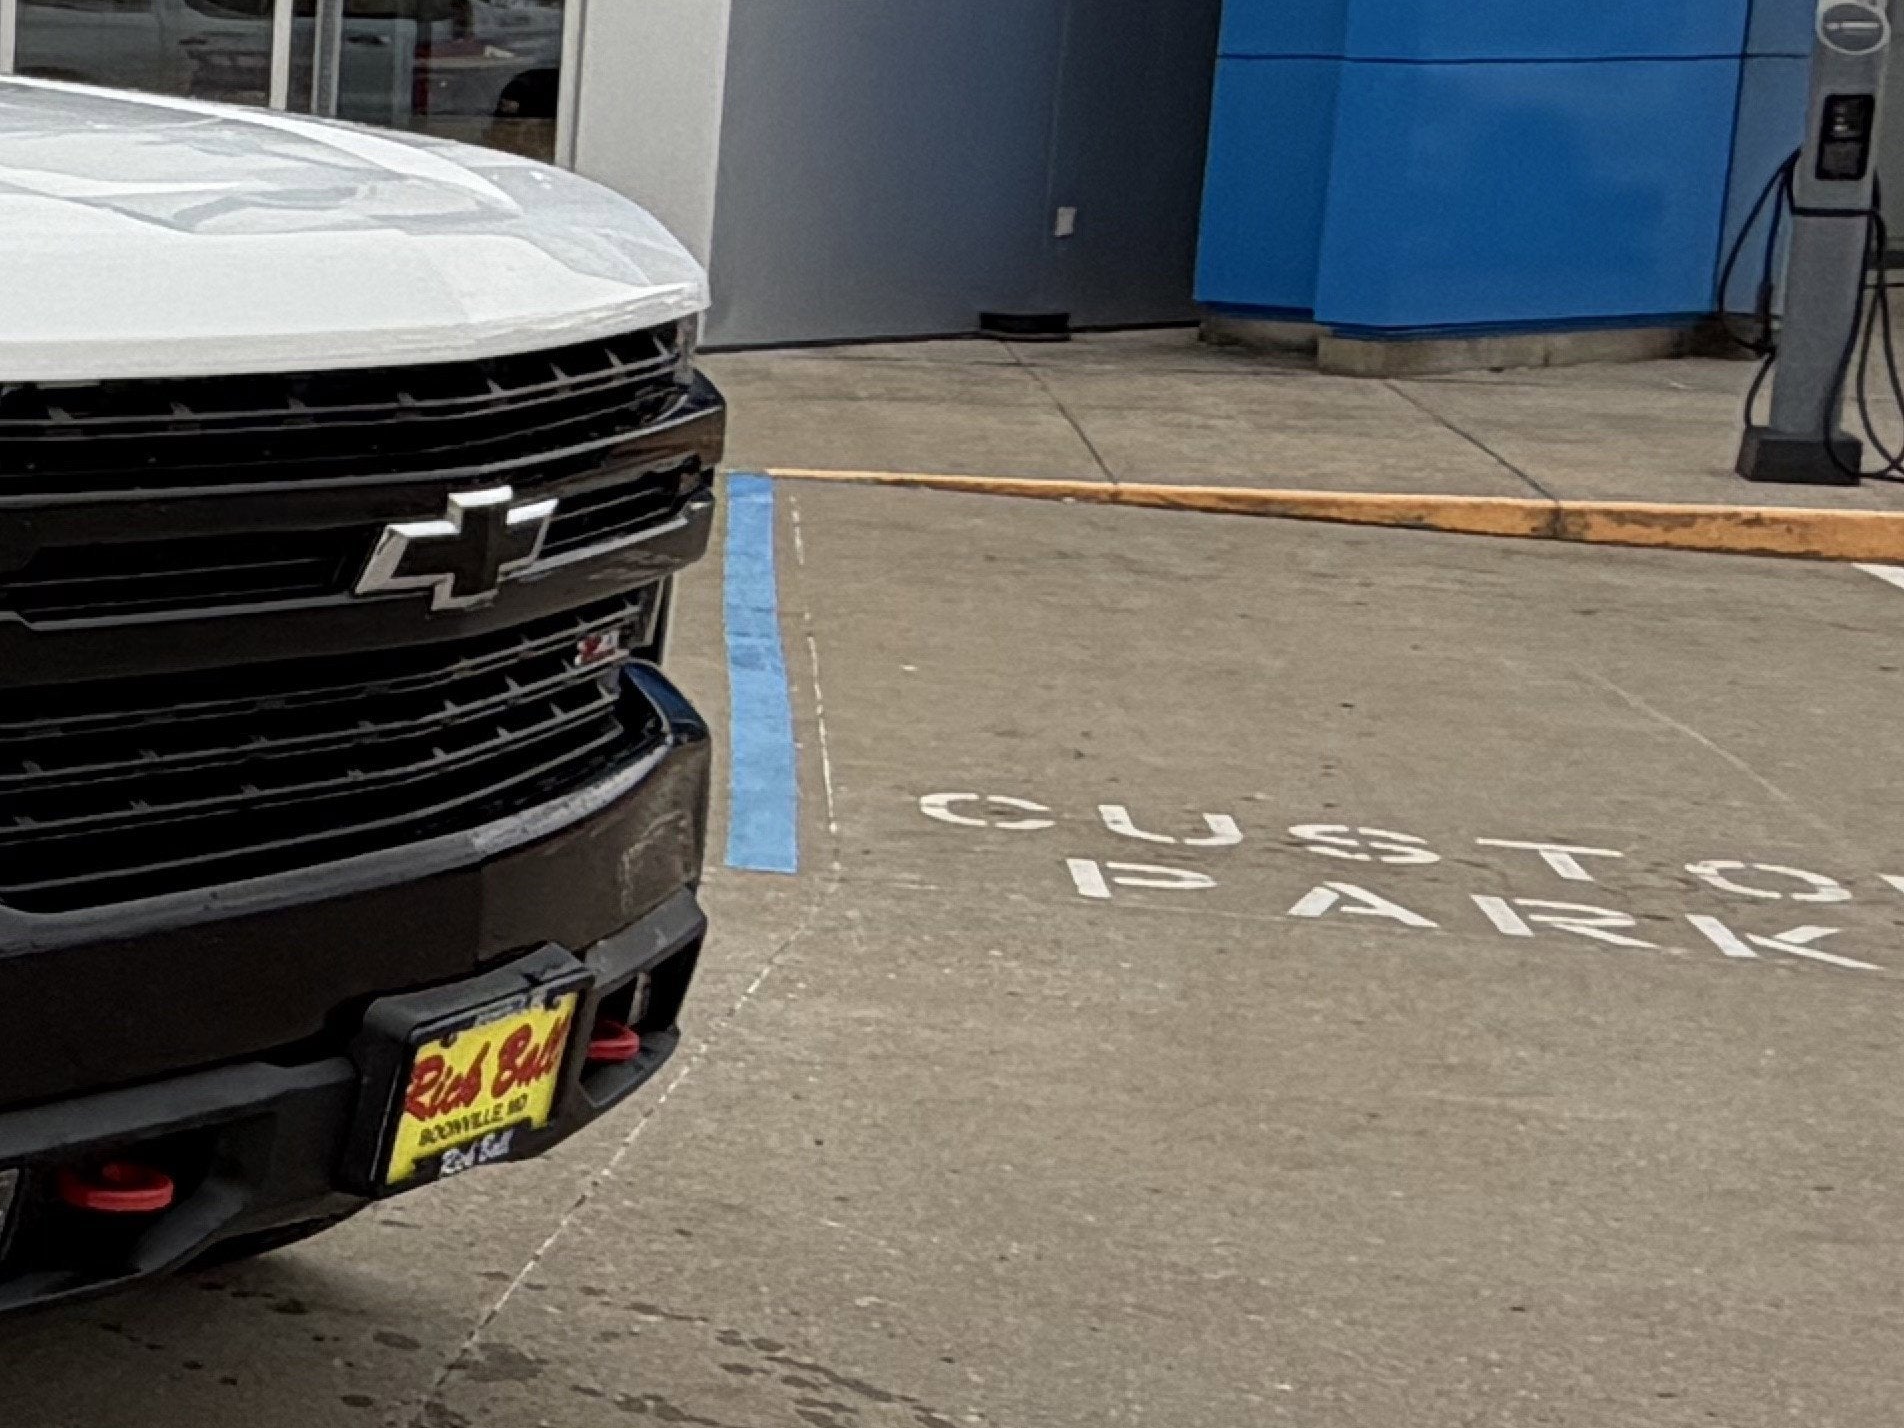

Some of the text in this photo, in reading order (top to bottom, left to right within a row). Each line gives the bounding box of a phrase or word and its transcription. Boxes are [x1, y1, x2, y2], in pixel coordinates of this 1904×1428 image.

[919, 791, 1904, 904] CUSTO
[1065, 856, 1885, 971] PARK
[404, 1015, 571, 1122] Rick Ball
